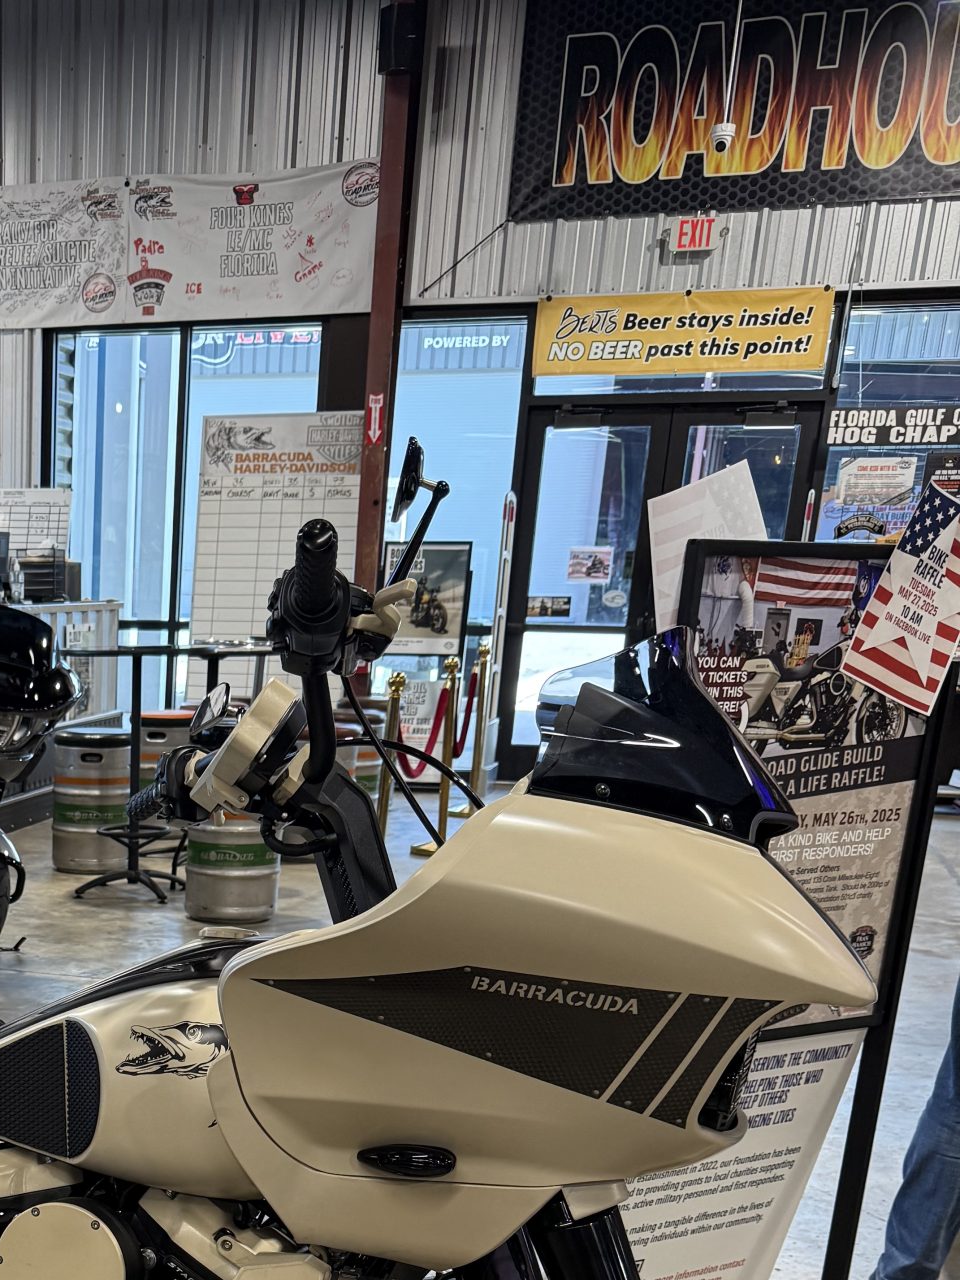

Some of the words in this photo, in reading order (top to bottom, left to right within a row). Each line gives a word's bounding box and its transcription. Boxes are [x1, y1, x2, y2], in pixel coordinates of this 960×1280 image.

[210, 204, 245, 229] FOUR
[249, 202, 294, 228] KINGS
[33, 219, 58, 242] FOR
[226, 228, 273, 253] LE/MC
[677, 218, 716, 250] EXIT
[134, 237, 165, 256] Padre
[9, 264, 81, 290] INITIATIVE
[220, 252, 278, 278] FLORIDA
[294, 260, 324, 283] Gnome
[185, 282, 202, 294] ICE
[623, 312, 673, 331] Beer
[676, 311, 734, 334] stays
[738, 306, 814, 328] inside!
[423, 336, 489, 349] POWERED
[491, 335, 510, 347] BY
[547, 342, 585, 362] NO
[587, 340, 644, 361] BEER
[645, 340, 694, 363] past
[699, 338, 740, 356] this
[743, 335, 813, 360] point!
[829, 409, 897, 427] FLORIDA
[905, 408, 947, 426] GULF
[827, 427, 878, 445] HOG
[889, 425, 960, 444] CHAP
[234, 463, 356, 475] HARLEY-DAVIDSON
[235, 451, 314, 463] BARRACUDA
[927, 544, 949, 569] BIKE
[913, 558, 946, 589] RAFFLE
[897, 585, 912, 601] MAY
[920, 600, 939, 617] 2025
[908, 577, 936, 603] TUESDAY,
[884, 611, 895, 623] ON
[892, 616, 919, 638] FACEBOOK
[917, 631, 931, 645] LIVE
[900, 604, 911, 619] 10
[909, 610, 924, 627] AM
[697, 656, 718, 669] YOU
[720, 656, 740, 668] CAN
[708, 671, 748, 683] TICKETS
[722, 686, 743, 698] THIS
[766, 758, 797, 777] OAD
[800, 751, 841, 772] GLIDE
[842, 745, 883, 766] BUILD
[786, 779, 796, 796] A
[800, 774, 829, 794] LIFE
[831, 765, 886, 788] RAFFLE!
[811, 811, 838, 828] MAY
[840, 811, 869, 826] 26TH,
[871, 807, 902, 823] 2025
[787, 833, 813, 847] KIND
[815, 831, 840, 844] BIKE
[841, 829, 863, 842] AND
[864, 828, 892, 841] HELP
[802, 843, 875, 860] RESPONDERS!
[471, 976, 639, 1015] BARRACUDA
[750, 1053, 788, 1073] SERVING
[787, 1050, 803, 1068] THE
[802, 1043, 854, 1065] COMMUNITY
[742, 1075, 779, 1095] HELPING
[778, 1071, 805, 1089] THOSE
[803, 1068, 824, 1084] WHO
[739, 1094, 759, 1110] HELP
[758, 1089, 790, 1107] OTHERS
[748, 1111, 773, 1129] NGING
[772, 1108, 797, 1125] LIVES
[637, 1167, 689, 1183] establishment
[690, 1165, 698, 1174] in
[697, 1160, 719, 1172] 2022,
[720, 1160, 732, 1168] our
[732, 1151, 772, 1166] Foundation
[772, 1149, 784, 1158] has
[784, 1145, 802, 1156] been
[636, 1188, 644, 1197] to
[644, 1181, 680, 1198] providing
[680, 1177, 703, 1190] grants
[704, 1175, 712, 1184] to
[713, 1170, 729, 1183] local
[730, 1165, 758, 1179] charities
[758, 1158, 796, 1175] supporting
[632, 1199, 654, 1211] active
[654, 1193, 684, 1207] military
[683, 1186, 718, 1202] personnel
[719, 1182, 733, 1193] and
[733, 1179, 747, 1190] first
[748, 1172, 786, 1189] responders.
[629, 1222, 656, 1236] making
[663, 1214, 694, 1230] tangible
[693, 1207, 729, 1223] difference
[729, 1206, 737, 1216] in
[737, 1204, 748, 1214] the
[749, 1200, 765, 1212] lives
[765, 1197, 775, 1209] of
[650, 1228, 689, 1244] individuals
[690, 1224, 712, 1236] within
[712, 1222, 725, 1232] our
[724, 1213, 764, 1229] community.
[674, 1264, 719, 1280] information
[719, 1258, 746, 1272] contact
